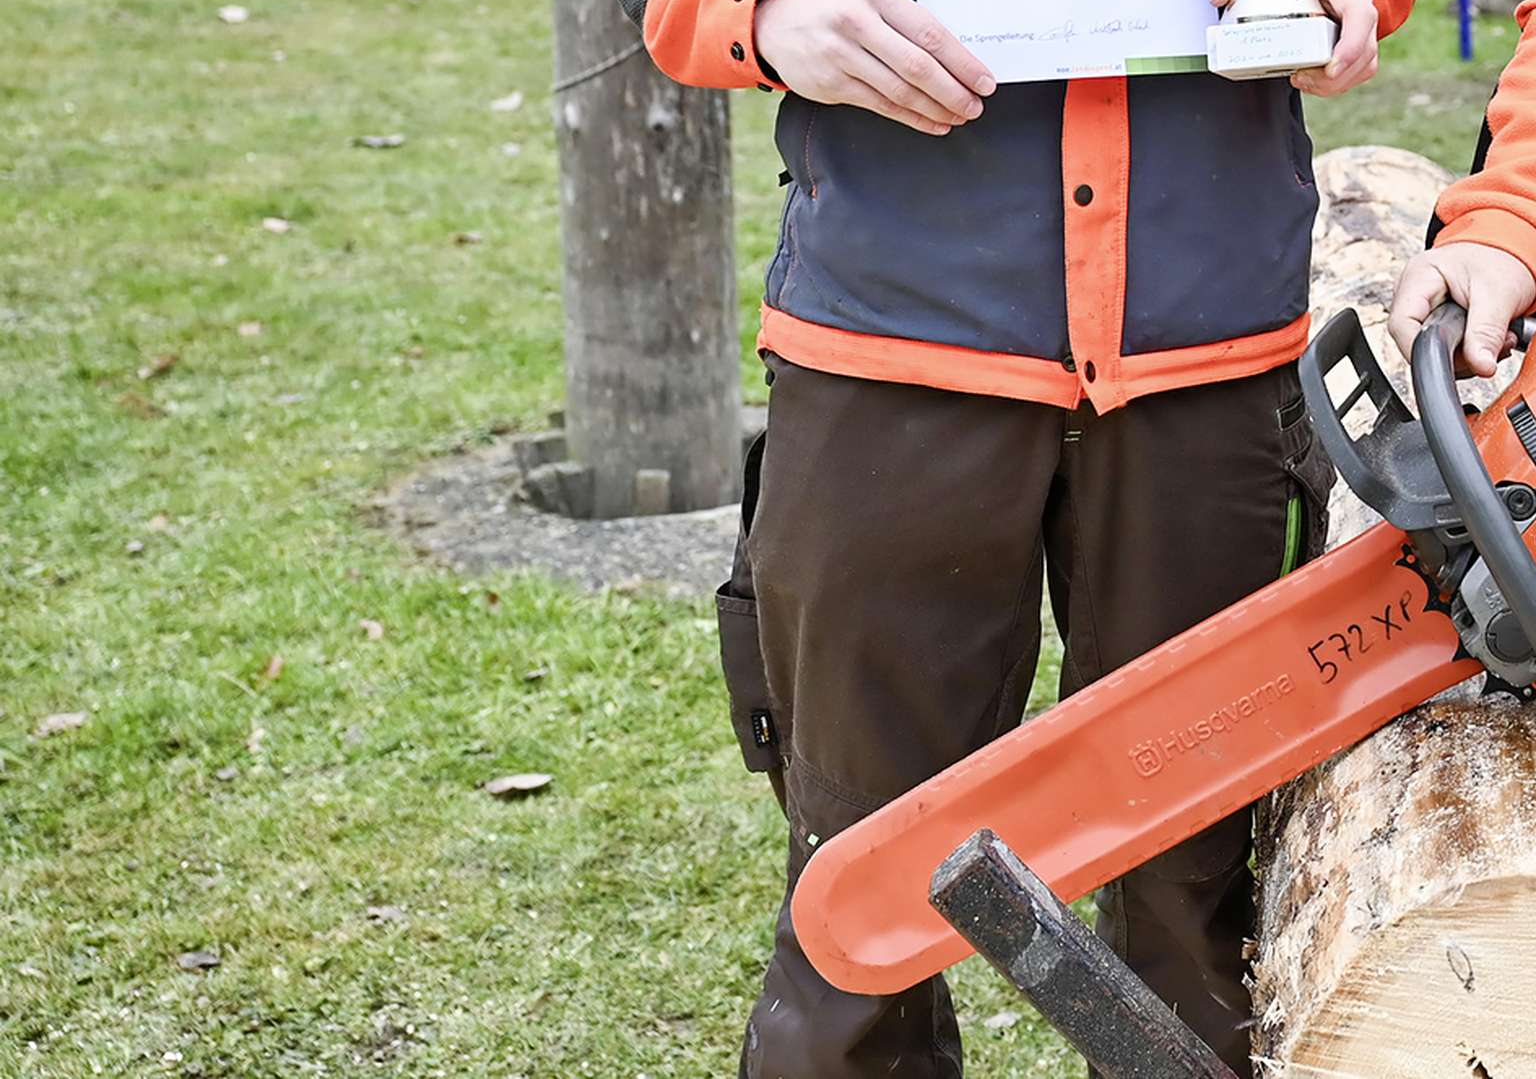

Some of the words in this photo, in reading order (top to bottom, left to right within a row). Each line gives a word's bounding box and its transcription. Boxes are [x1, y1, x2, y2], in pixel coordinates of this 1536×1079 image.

[1307, 623, 1374, 684] 572
[1371, 589, 1413, 641] XP
[1158, 670, 1296, 762] Husqvarna
